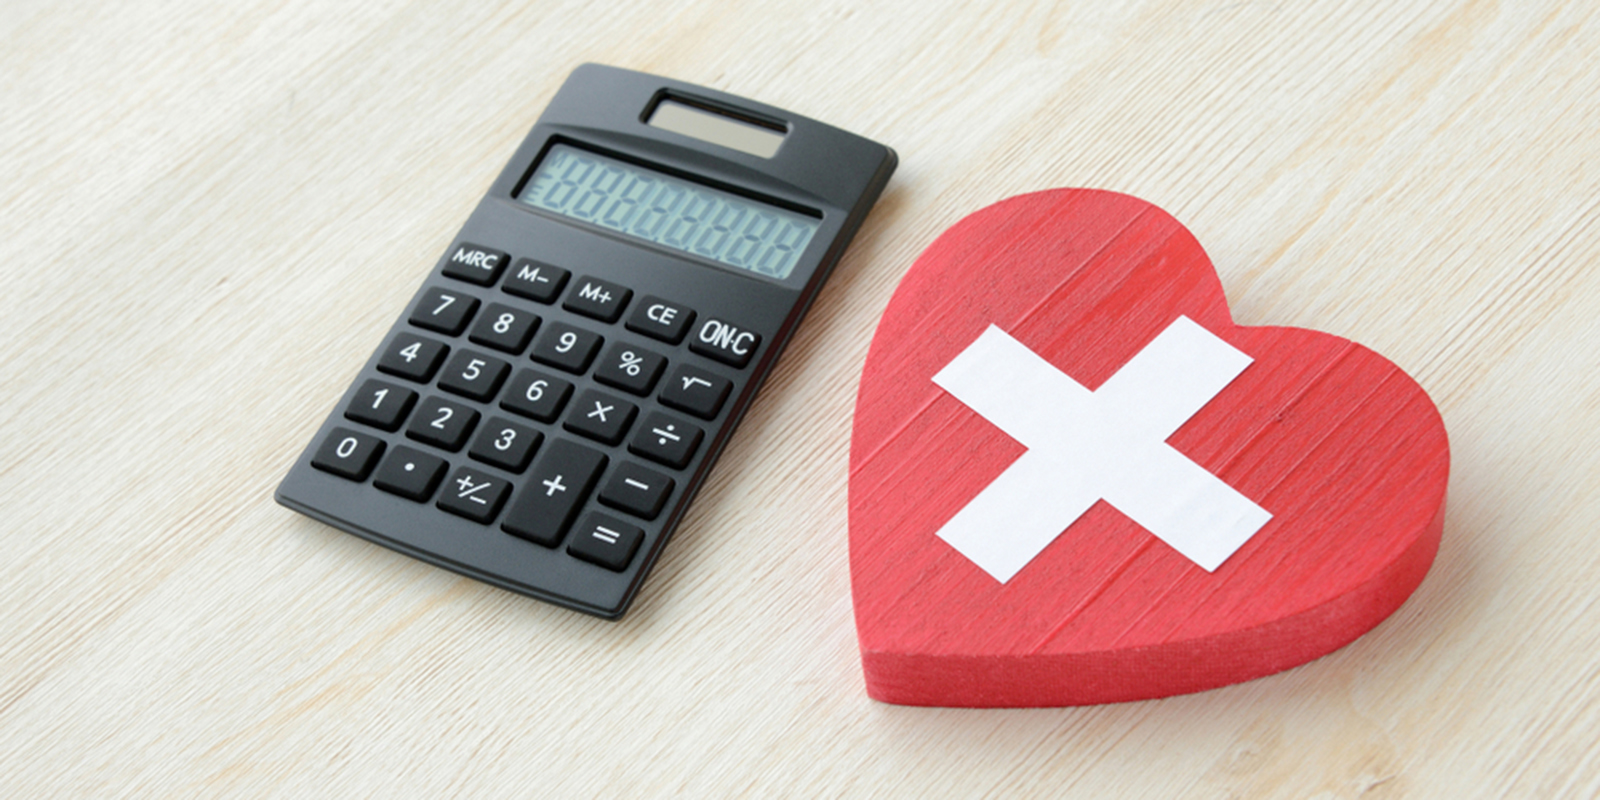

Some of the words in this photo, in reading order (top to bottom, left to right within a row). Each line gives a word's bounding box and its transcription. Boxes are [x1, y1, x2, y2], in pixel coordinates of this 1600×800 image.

[451, 247, 499, 270] MRC
[578, 282, 612, 304] M+
[432, 294, 456, 316] 7
[647, 304, 678, 325] CE
[492, 312, 515, 334] 8
[399, 341, 422, 363] 4
[555, 331, 578, 353] 9
[461, 358, 486, 381] 5
[618, 350, 643, 376] %
[372, 388, 389, 409] 1
[525, 379, 549, 402] 6
[430, 406, 454, 429] 2
[335, 436, 358, 459] 0
[494, 428, 517, 451] 3
